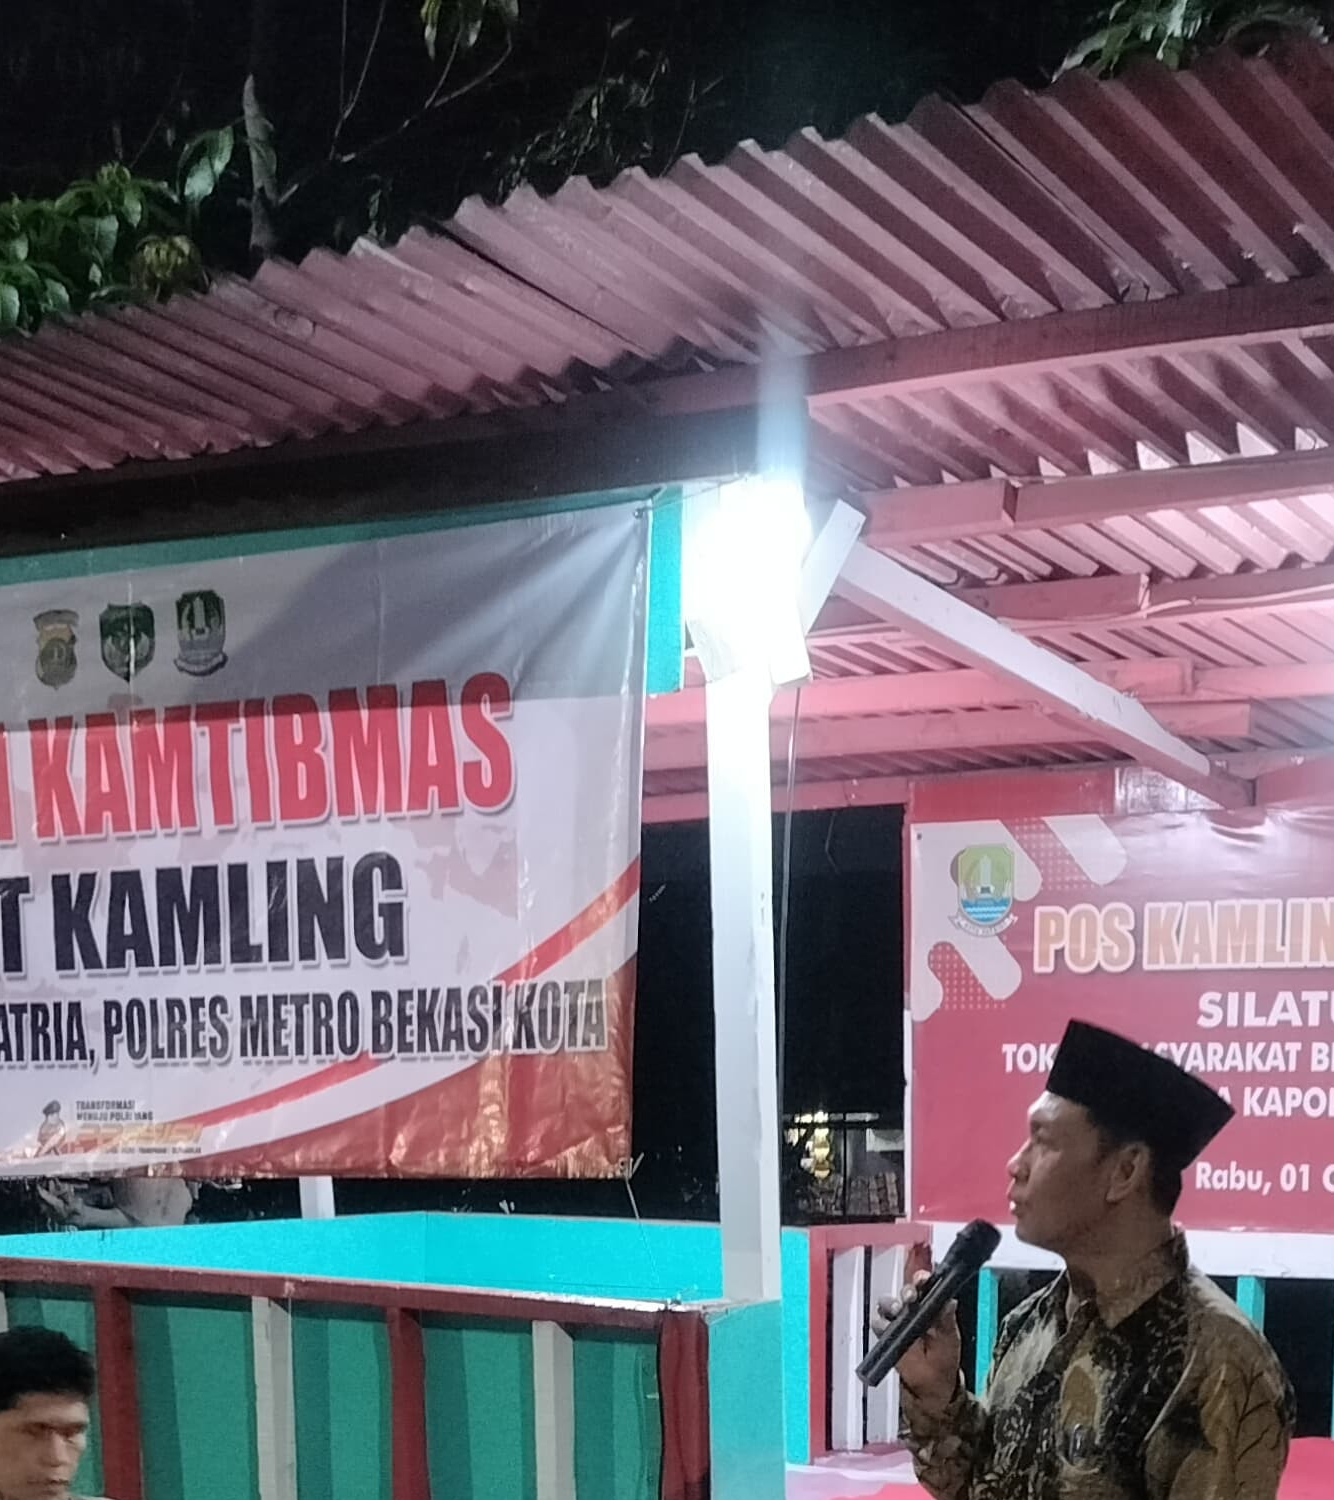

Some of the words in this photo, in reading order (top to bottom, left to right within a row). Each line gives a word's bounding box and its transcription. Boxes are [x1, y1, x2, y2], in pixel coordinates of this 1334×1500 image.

[31, 671, 516, 844] KAMTIBMAS
[53, 851, 407, 976] KAMLING
[1033, 900, 1135, 976] POS
[103, 992, 230, 1065] POLRES
[238, 990, 362, 1063] METRO
[370, 981, 503, 1059] BEKASI
[513, 979, 608, 1053] KOTA
[1195, 1162, 1271, 1196] Rabu,
[1279, 1165, 1313, 1193] 01
